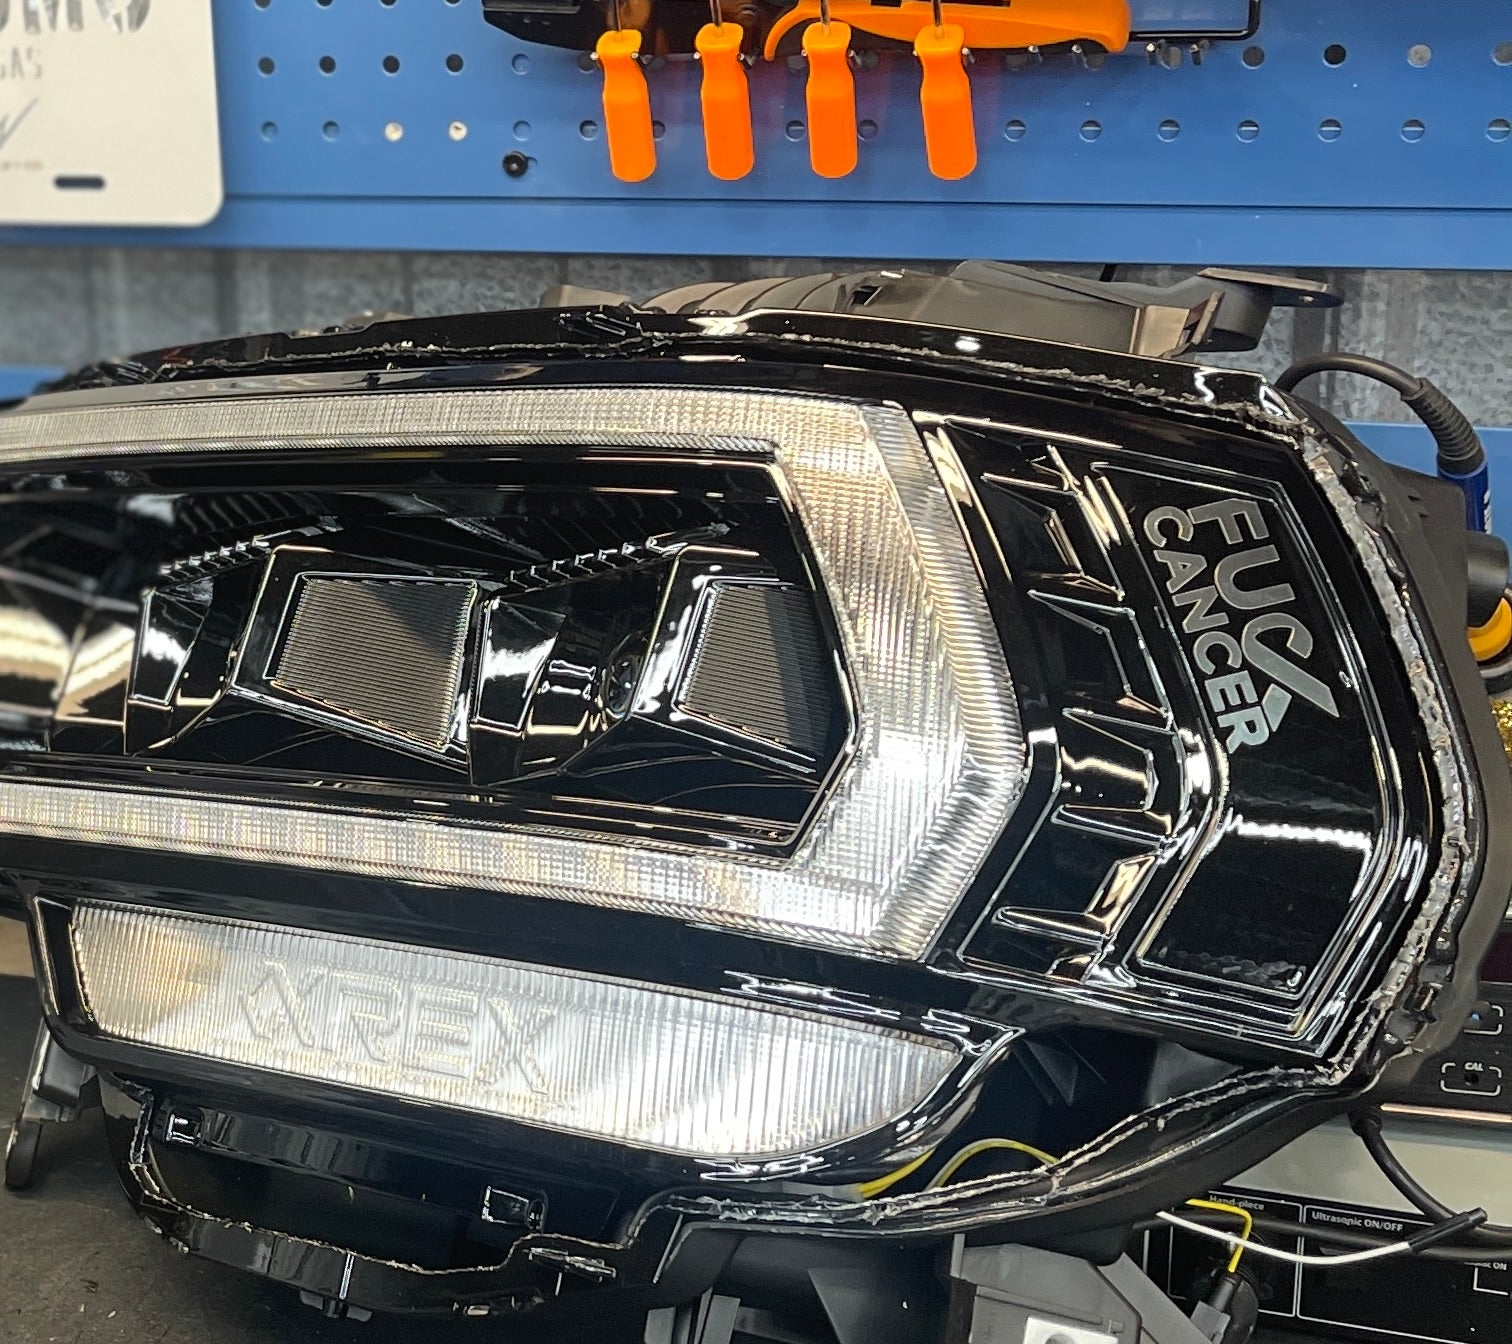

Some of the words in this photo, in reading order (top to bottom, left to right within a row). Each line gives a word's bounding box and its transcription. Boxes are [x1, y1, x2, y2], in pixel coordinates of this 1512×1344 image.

[1143, 505, 1273, 754] CANCER
[1464, 1062, 1484, 1071] CAL
[1311, 1210, 1362, 1227] Ultrasonic
[1363, 1218, 1404, 1232] ON/OFF
